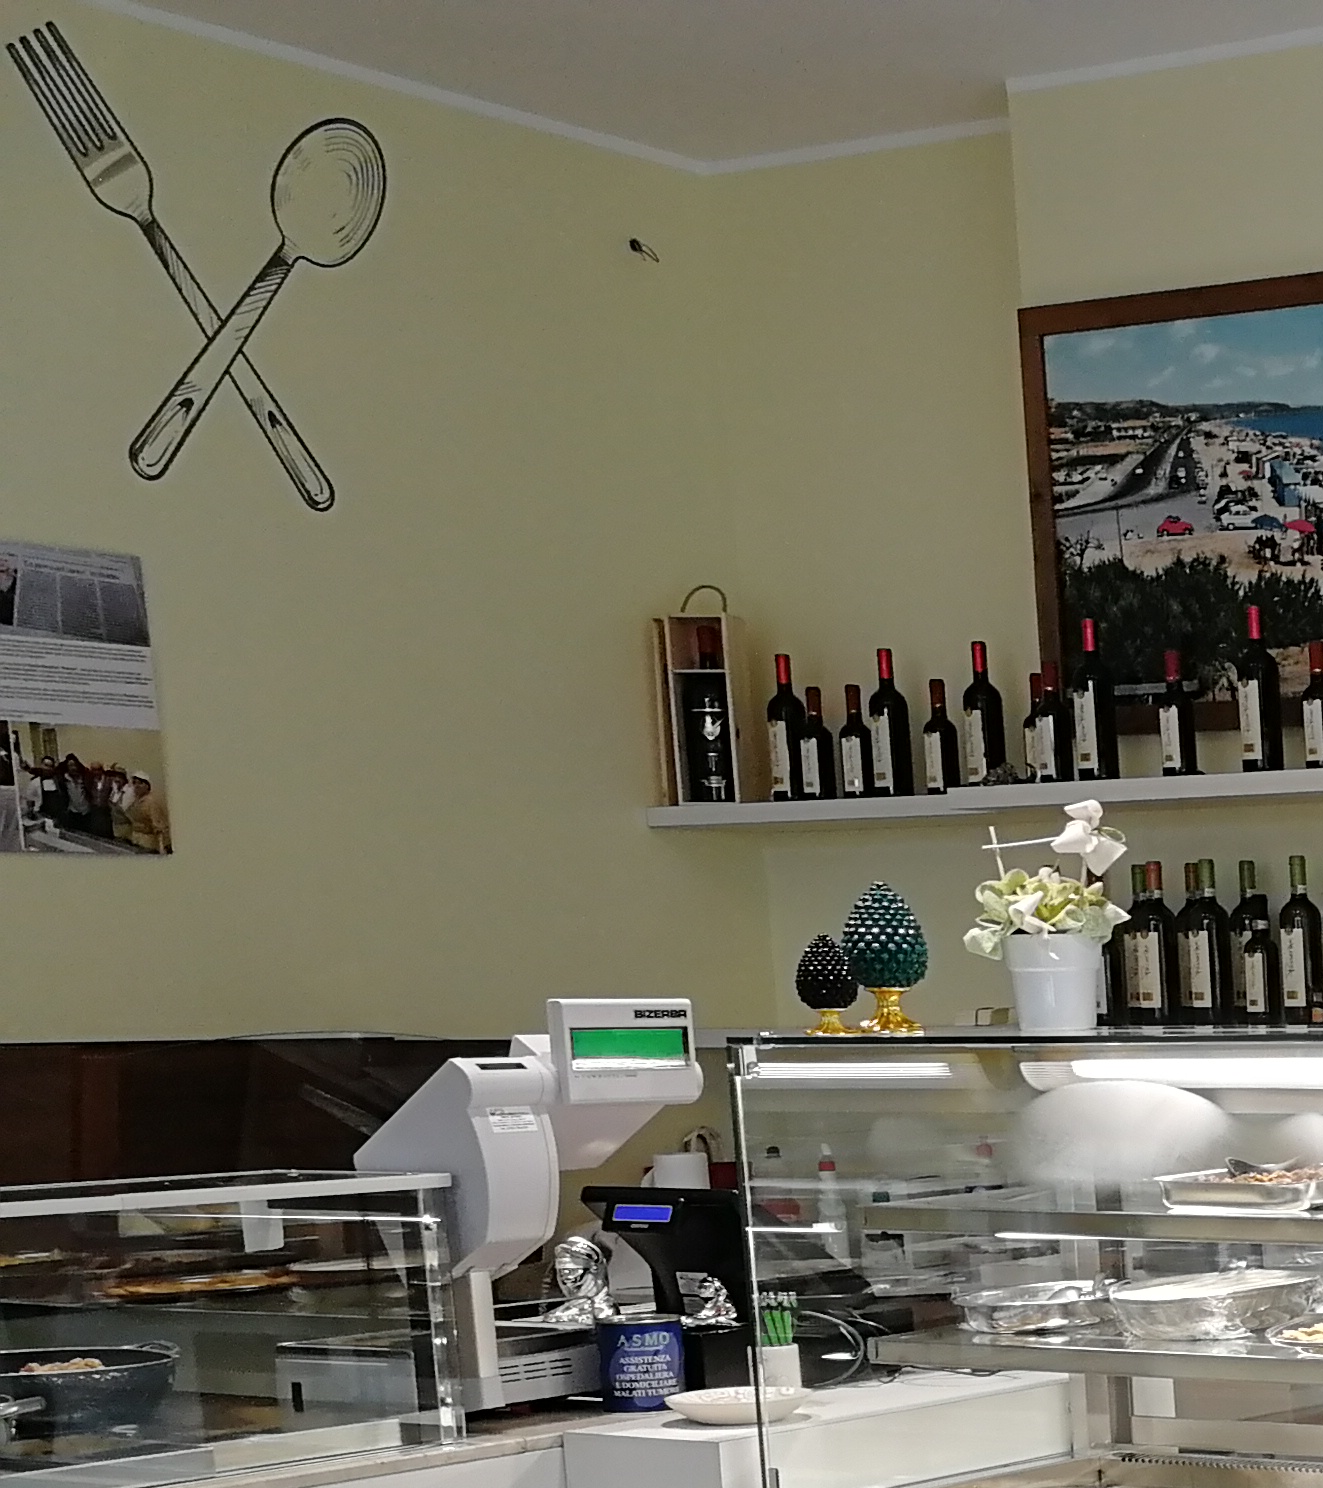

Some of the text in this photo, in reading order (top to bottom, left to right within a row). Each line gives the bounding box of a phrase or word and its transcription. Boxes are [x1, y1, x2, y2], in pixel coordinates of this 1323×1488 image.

[633, 1009, 687, 1019] BIZERBA
[619, 1354, 672, 1364] ASSISTENZA
[623, 1363, 668, 1373] GRATUITA
